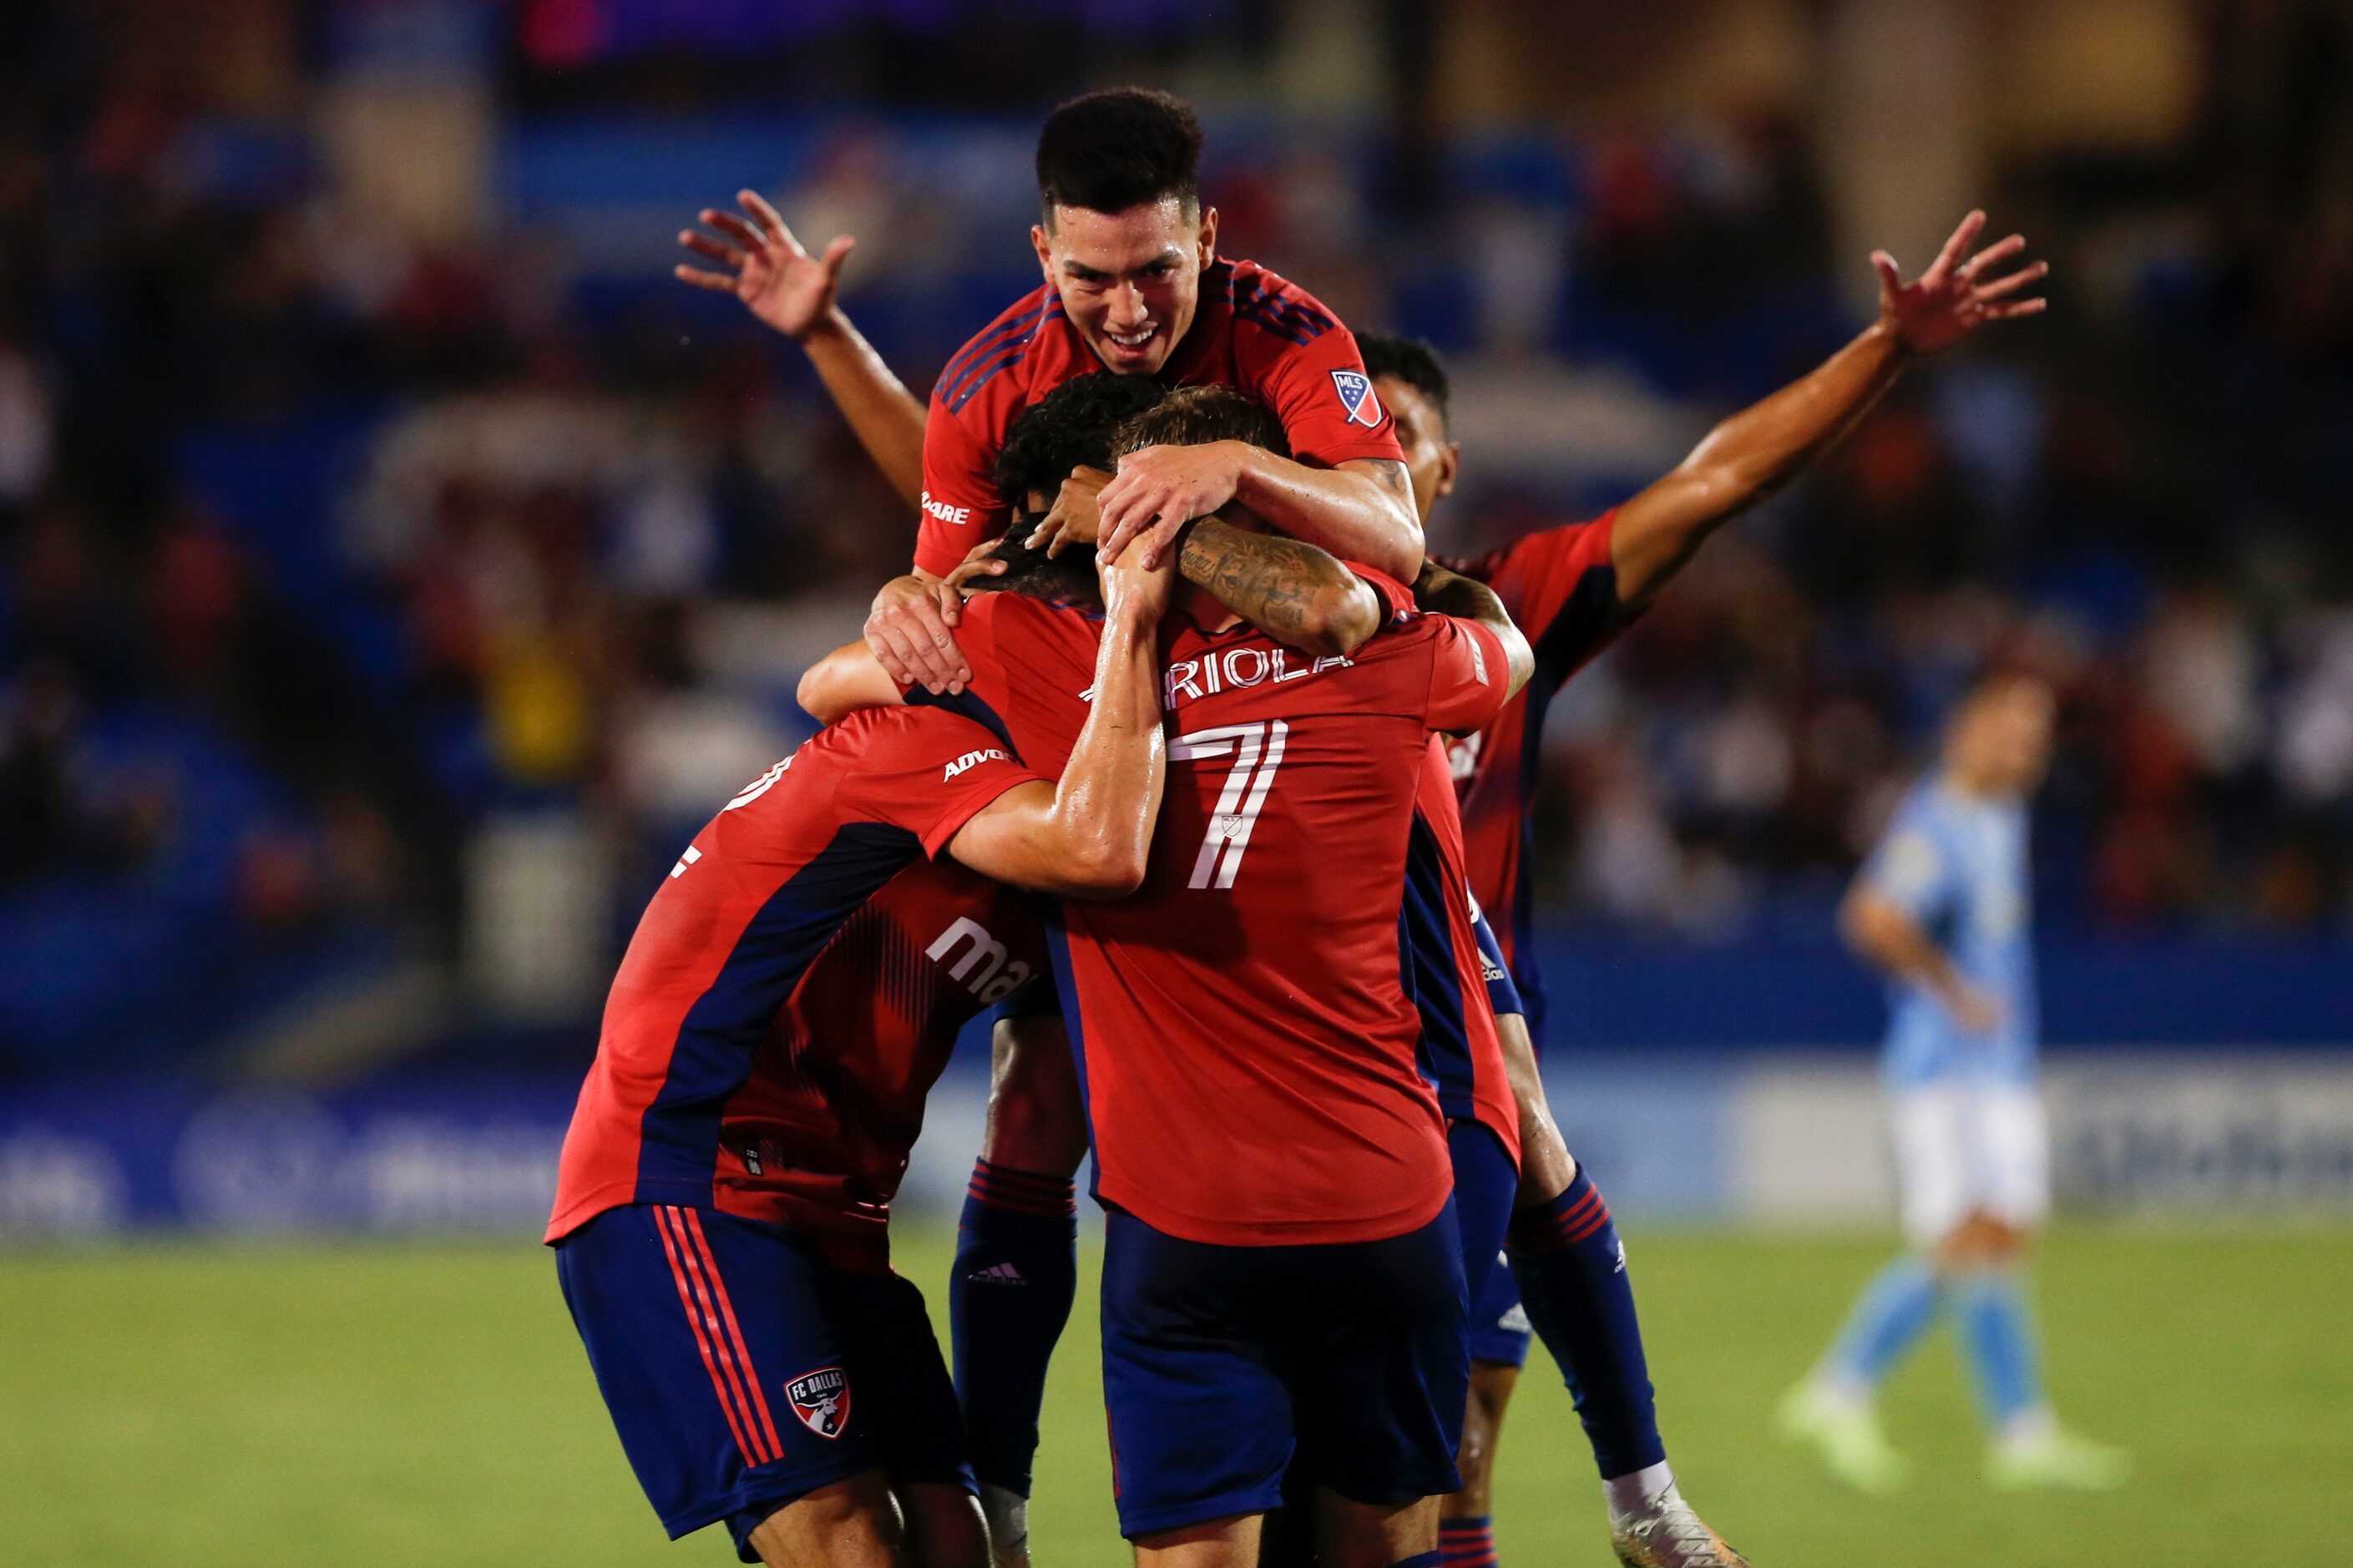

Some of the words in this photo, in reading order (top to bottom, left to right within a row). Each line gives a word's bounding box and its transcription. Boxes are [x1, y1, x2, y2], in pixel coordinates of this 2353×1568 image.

[1338, 376, 1363, 390] MLS
[1166, 719, 1288, 889] 7
[792, 1383, 807, 1401] FC
[807, 1372, 843, 1393] DALLAS
